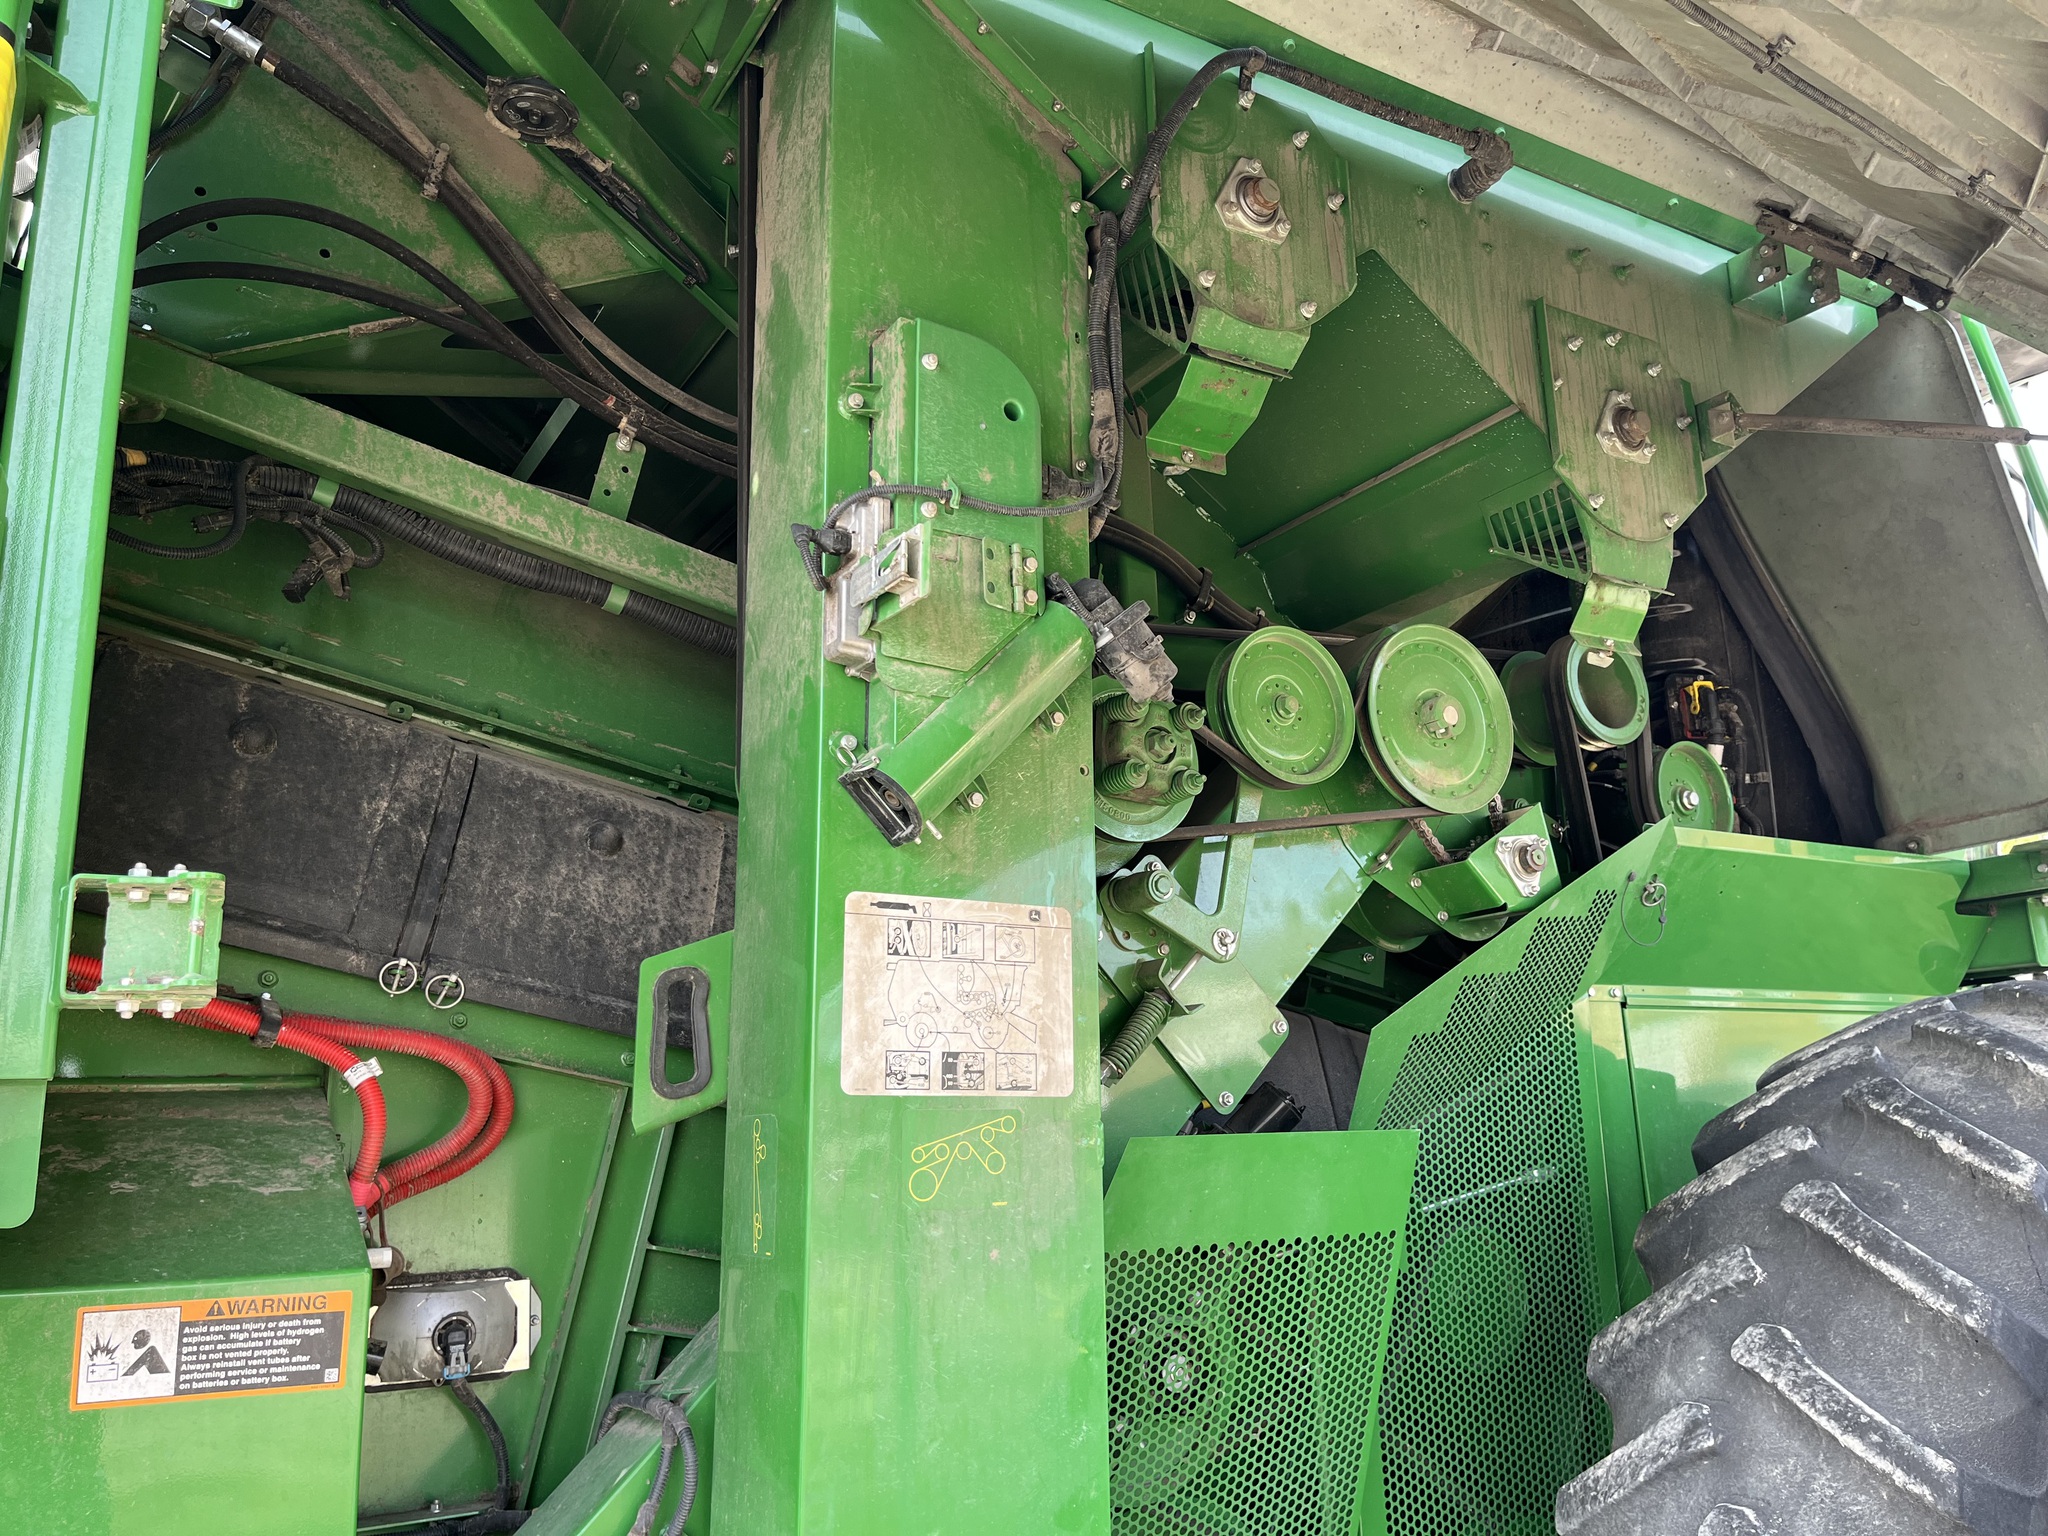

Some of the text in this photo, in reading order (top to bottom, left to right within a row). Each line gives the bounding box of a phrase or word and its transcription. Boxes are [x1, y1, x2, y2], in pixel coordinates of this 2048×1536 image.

[227, 1295, 327, 1315] WARNING
[183, 1325, 208, 1334] Avoid
[210, 1324, 240, 1332] serious
[243, 1322, 266, 1331] injury
[278, 1319, 301, 1328] death
[302, 1318, 322, 1326] from
[182, 1327, 325, 1344] explosion. High levels of hydrogen
[182, 1345, 198, 1354] gas
[216, 1340, 264, 1350] accumulate
[272, 1338, 302, 1346] battery
[180, 1354, 310, 1372] Always reinstall vent tubes after
[181, 1354, 197, 1362] box
[208, 1352, 222, 1360] not
[224, 1350, 252, 1358] vented
[254, 1348, 290, 1358] properly.
[180, 1370, 226, 1382] performing
[227, 1368, 258, 1377] service
[270, 1363, 320, 1374] maintenance
[179, 1374, 290, 1390] on batteries or battery box.
